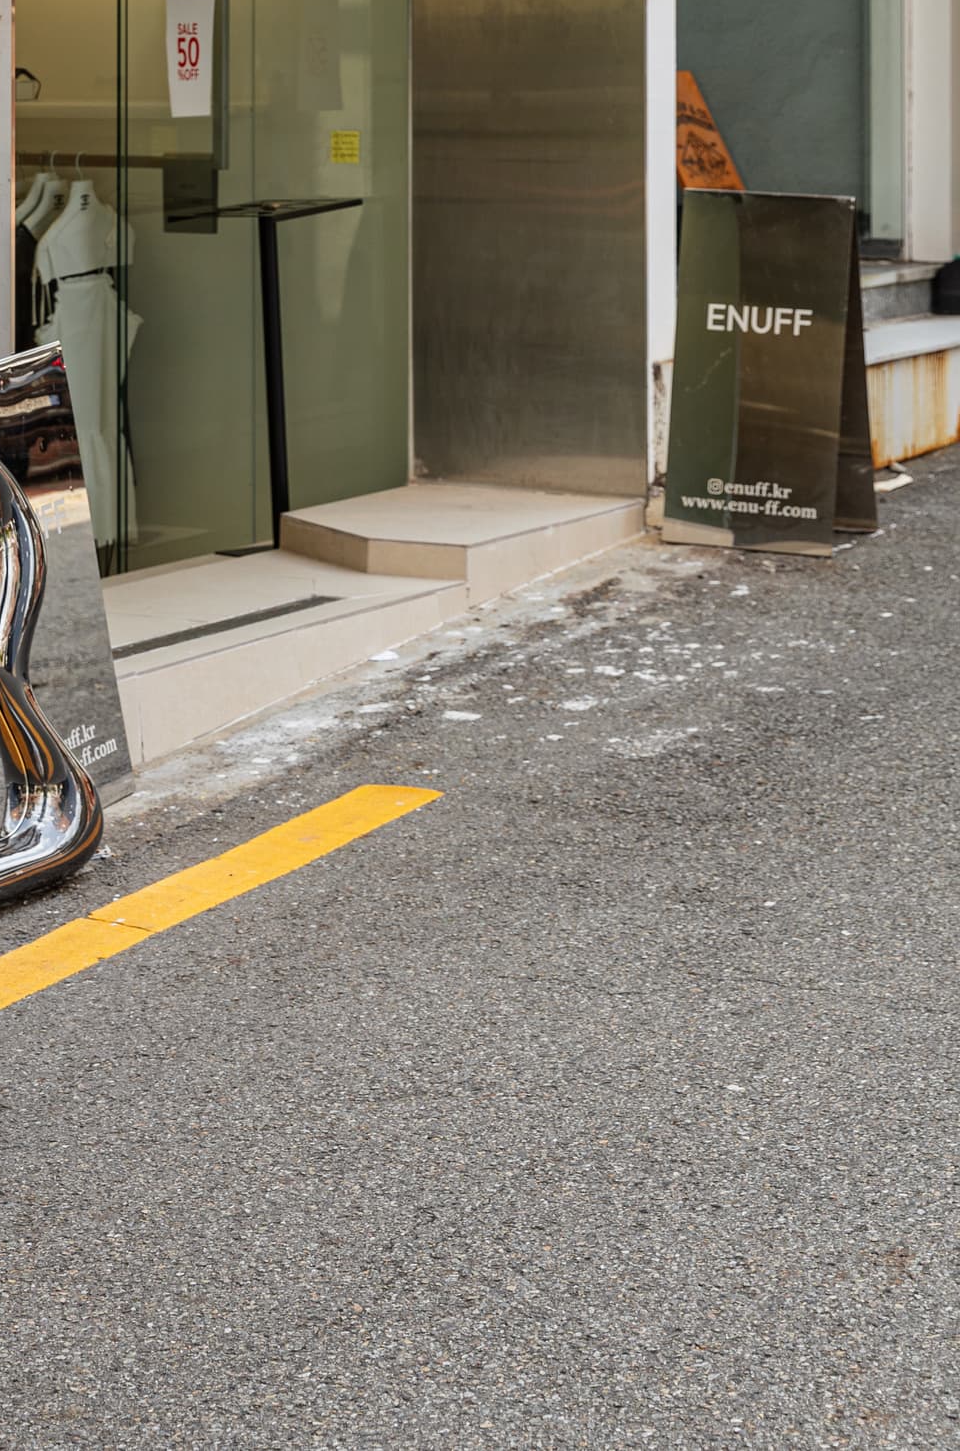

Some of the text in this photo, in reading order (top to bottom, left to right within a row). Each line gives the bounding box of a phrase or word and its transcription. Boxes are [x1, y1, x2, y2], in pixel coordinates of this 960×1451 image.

[177, 22, 199, 35] SALE
[177, 37, 200, 68] 50
[706, 303, 813, 336] ENUFF
[724, 481, 792, 499] enuff.kr
[681, 495, 818, 520] www.enu-ff.com
[63, 724, 96, 750] uff.kr
[80, 738, 118, 767] -ff.com
